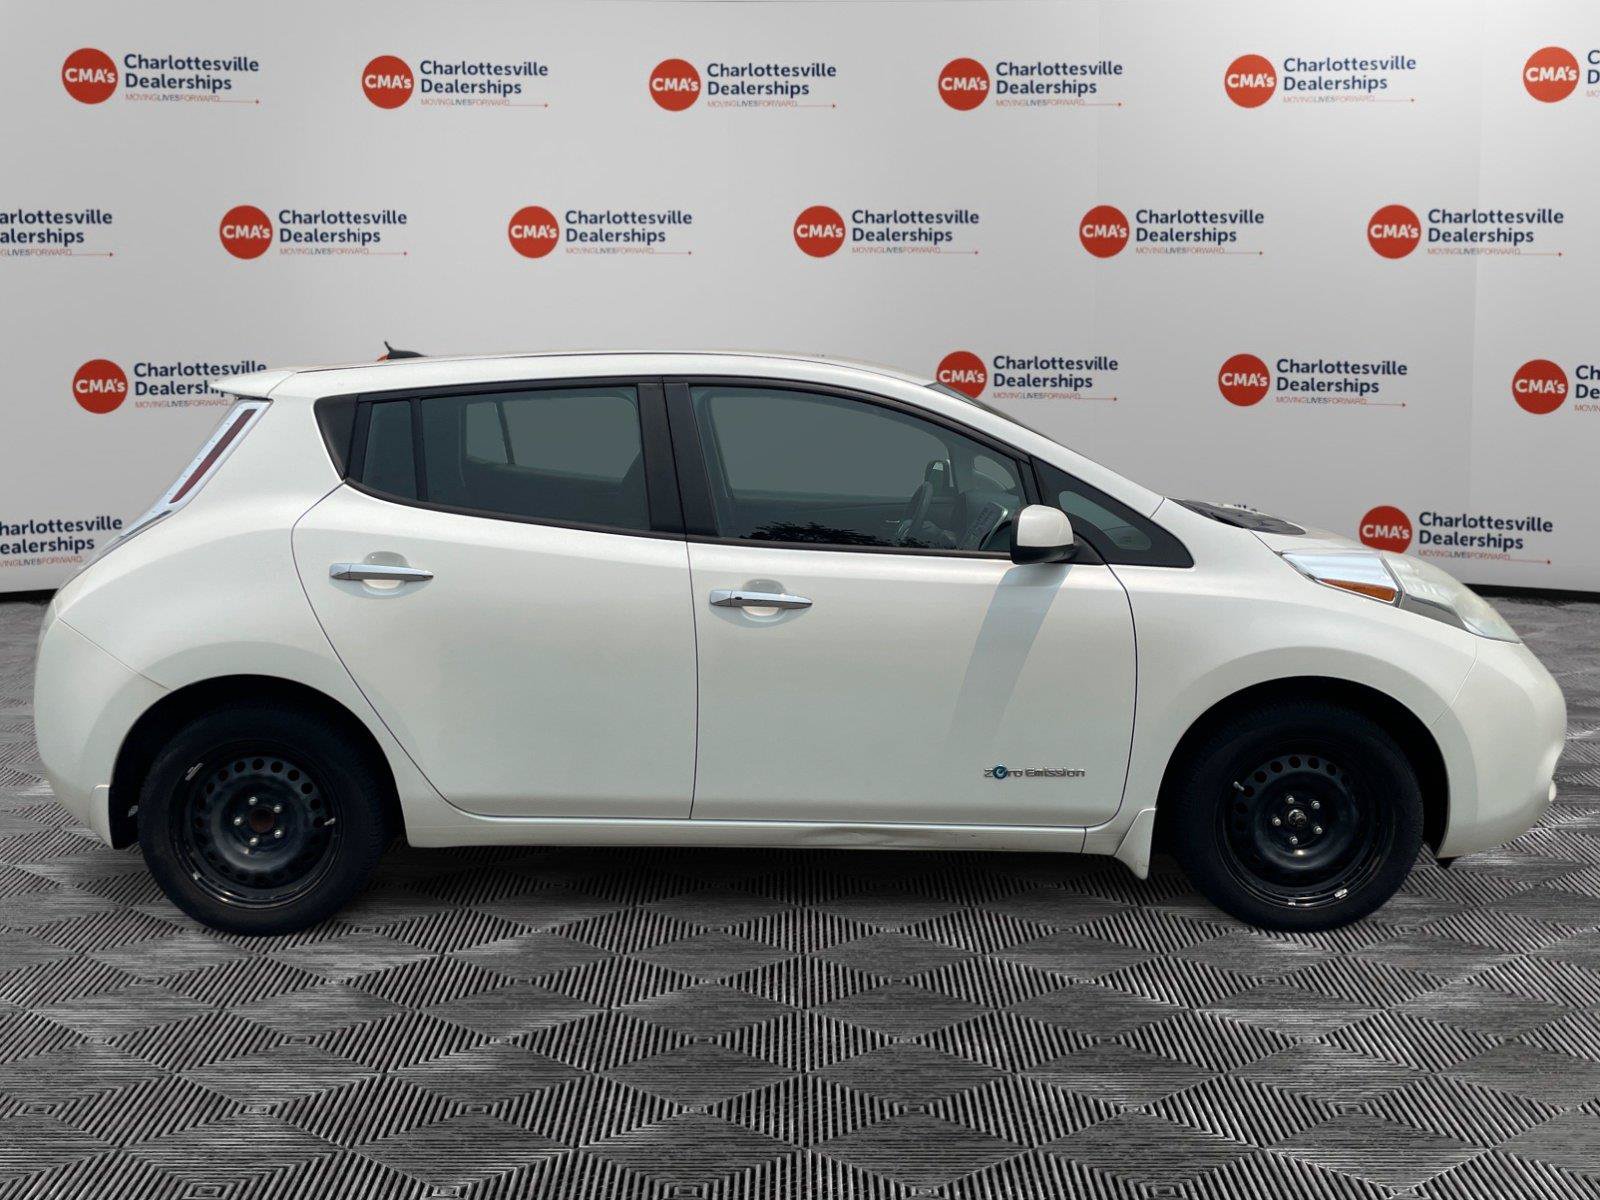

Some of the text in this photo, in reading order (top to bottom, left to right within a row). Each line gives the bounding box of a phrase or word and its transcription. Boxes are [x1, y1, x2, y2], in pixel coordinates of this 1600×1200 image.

[124, 53, 259, 72] Charlottesville
[419, 60, 548, 76] Charlottesville
[706, 62, 837, 78] Charlottesville
[995, 60, 1123, 77] Charlottesville
[1283, 55, 1416, 73] Charlottesville
[65, 67, 115, 84] CMA's
[366, 74, 412, 90] CMA's
[1227, 72, 1274, 89] CMA's
[1526, 65, 1577, 83] CMA's
[125, 72, 232, 94] Dealerships
[420, 78, 522, 98] Dealerships
[653, 77, 698, 92] CMA's
[708, 80, 810, 99] Dealerships
[942, 76, 987, 91] CMA's
[996, 79, 1097, 98] Dealerships
[1283, 74, 1388, 94] Dealerships
[278, 209, 407, 225] Charlottesville
[565, 210, 692, 225] Charlottesville
[851, 209, 979, 224] Charlottesville
[1135, 209, 1264, 224] Charlottesville
[1428, 208, 1564, 224] Charlottesville
[223, 224, 271, 239] CMA's
[279, 228, 381, 246] Dealerships
[512, 224, 557, 239] CMA's
[566, 228, 666, 246] Dealerships
[797, 224, 843, 238] CMA's
[852, 227, 953, 246] Dealerships
[1082, 224, 1127, 238] CMA's
[1136, 227, 1237, 246] Dealerships
[1370, 223, 1419, 239] CMA's
[1428, 227, 1534, 247] Dealerships
[133, 360, 267, 378] Charlottesville
[993, 355, 1118, 371] Charlottesville
[1276, 358, 1408, 376] Charlottesville
[940, 369, 985, 385] CMA's
[993, 372, 1093, 392] Dealerships
[1222, 372, 1267, 387] CMA's
[75, 378, 124, 394] CMA's
[1276, 376, 1380, 397] Dealerships
[1516, 378, 1566, 394] CMA's
[1418, 511, 1553, 533] Charlottesville
[1363, 524, 1409, 540] CMA's
[1419, 529, 1524, 553] Dealerships
